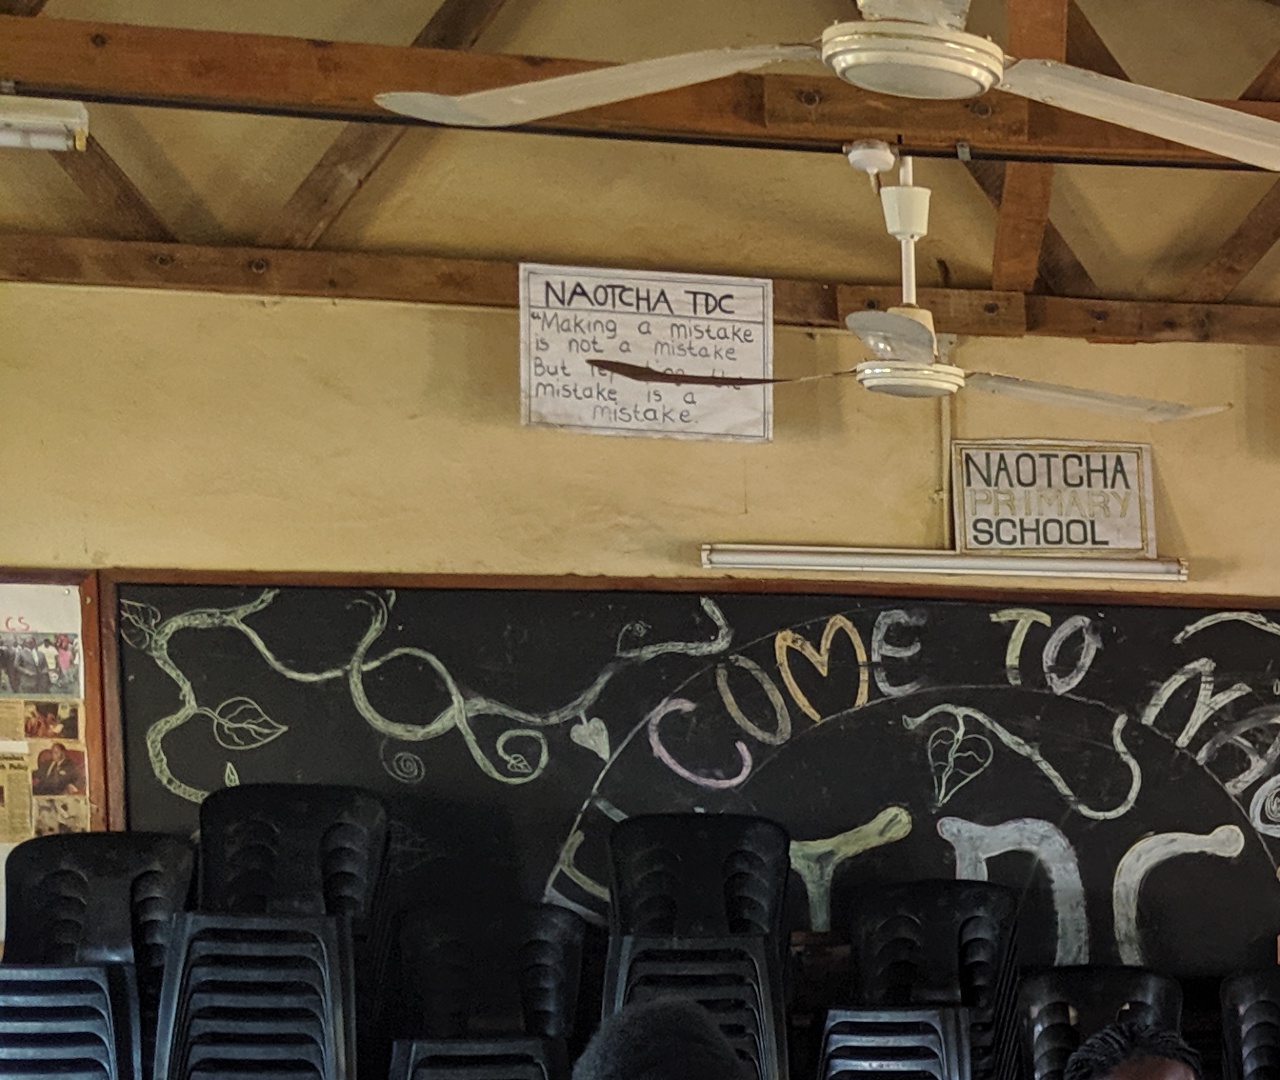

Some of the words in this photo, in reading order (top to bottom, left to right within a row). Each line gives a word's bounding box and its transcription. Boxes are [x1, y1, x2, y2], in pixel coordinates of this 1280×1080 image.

[544, 280, 674, 315] NAOTCHA
[684, 289, 735, 315] TDC
[637, 320, 651, 335] a
[670, 322, 754, 343] mistake
[535, 333, 549, 352] is
[568, 337, 604, 353] not
[619, 341, 631, 353] a
[654, 340, 736, 361] mistake
[534, 357, 571, 377] But
[535, 381, 617, 402] mistake
[647, 389, 662, 402] is
[683, 391, 696, 405] a
[593, 403, 699, 424] mistake.
[964, 452, 1132, 490] NAOTCHA
[969, 488, 1132, 518] PRIMARY
[972, 517, 1109, 545] SCHOOL
[990, 607, 1104, 697] TO
